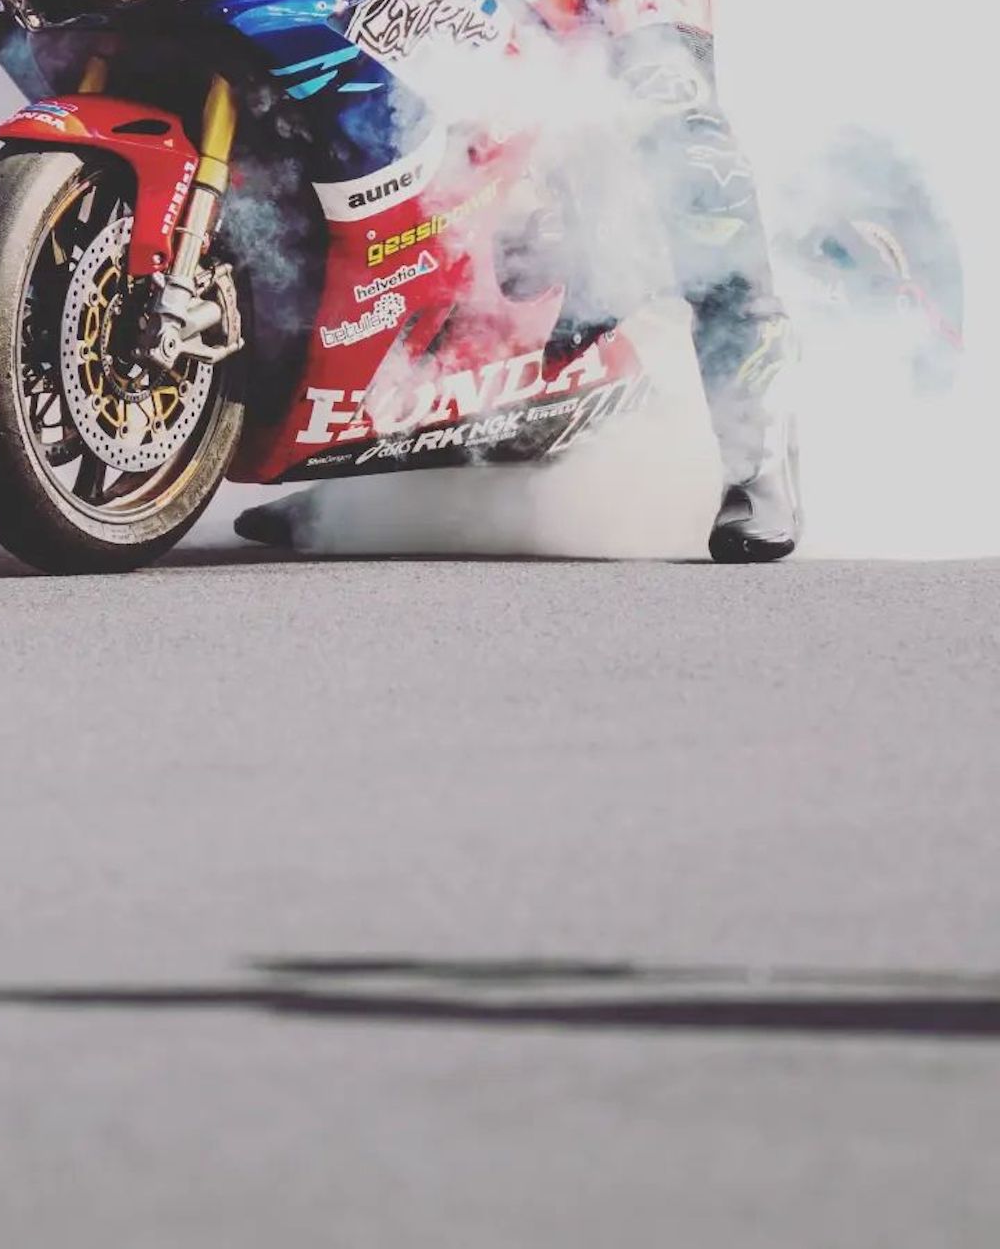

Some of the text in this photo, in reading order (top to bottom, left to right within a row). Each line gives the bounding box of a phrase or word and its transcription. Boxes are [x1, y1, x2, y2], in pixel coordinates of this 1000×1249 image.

[348, 164, 424, 209] auner
[356, 268, 417, 301] helvetia
[295, 343, 608, 445] HONDA
[412, 421, 470, 453] RK
[468, 410, 525, 440] NGK
